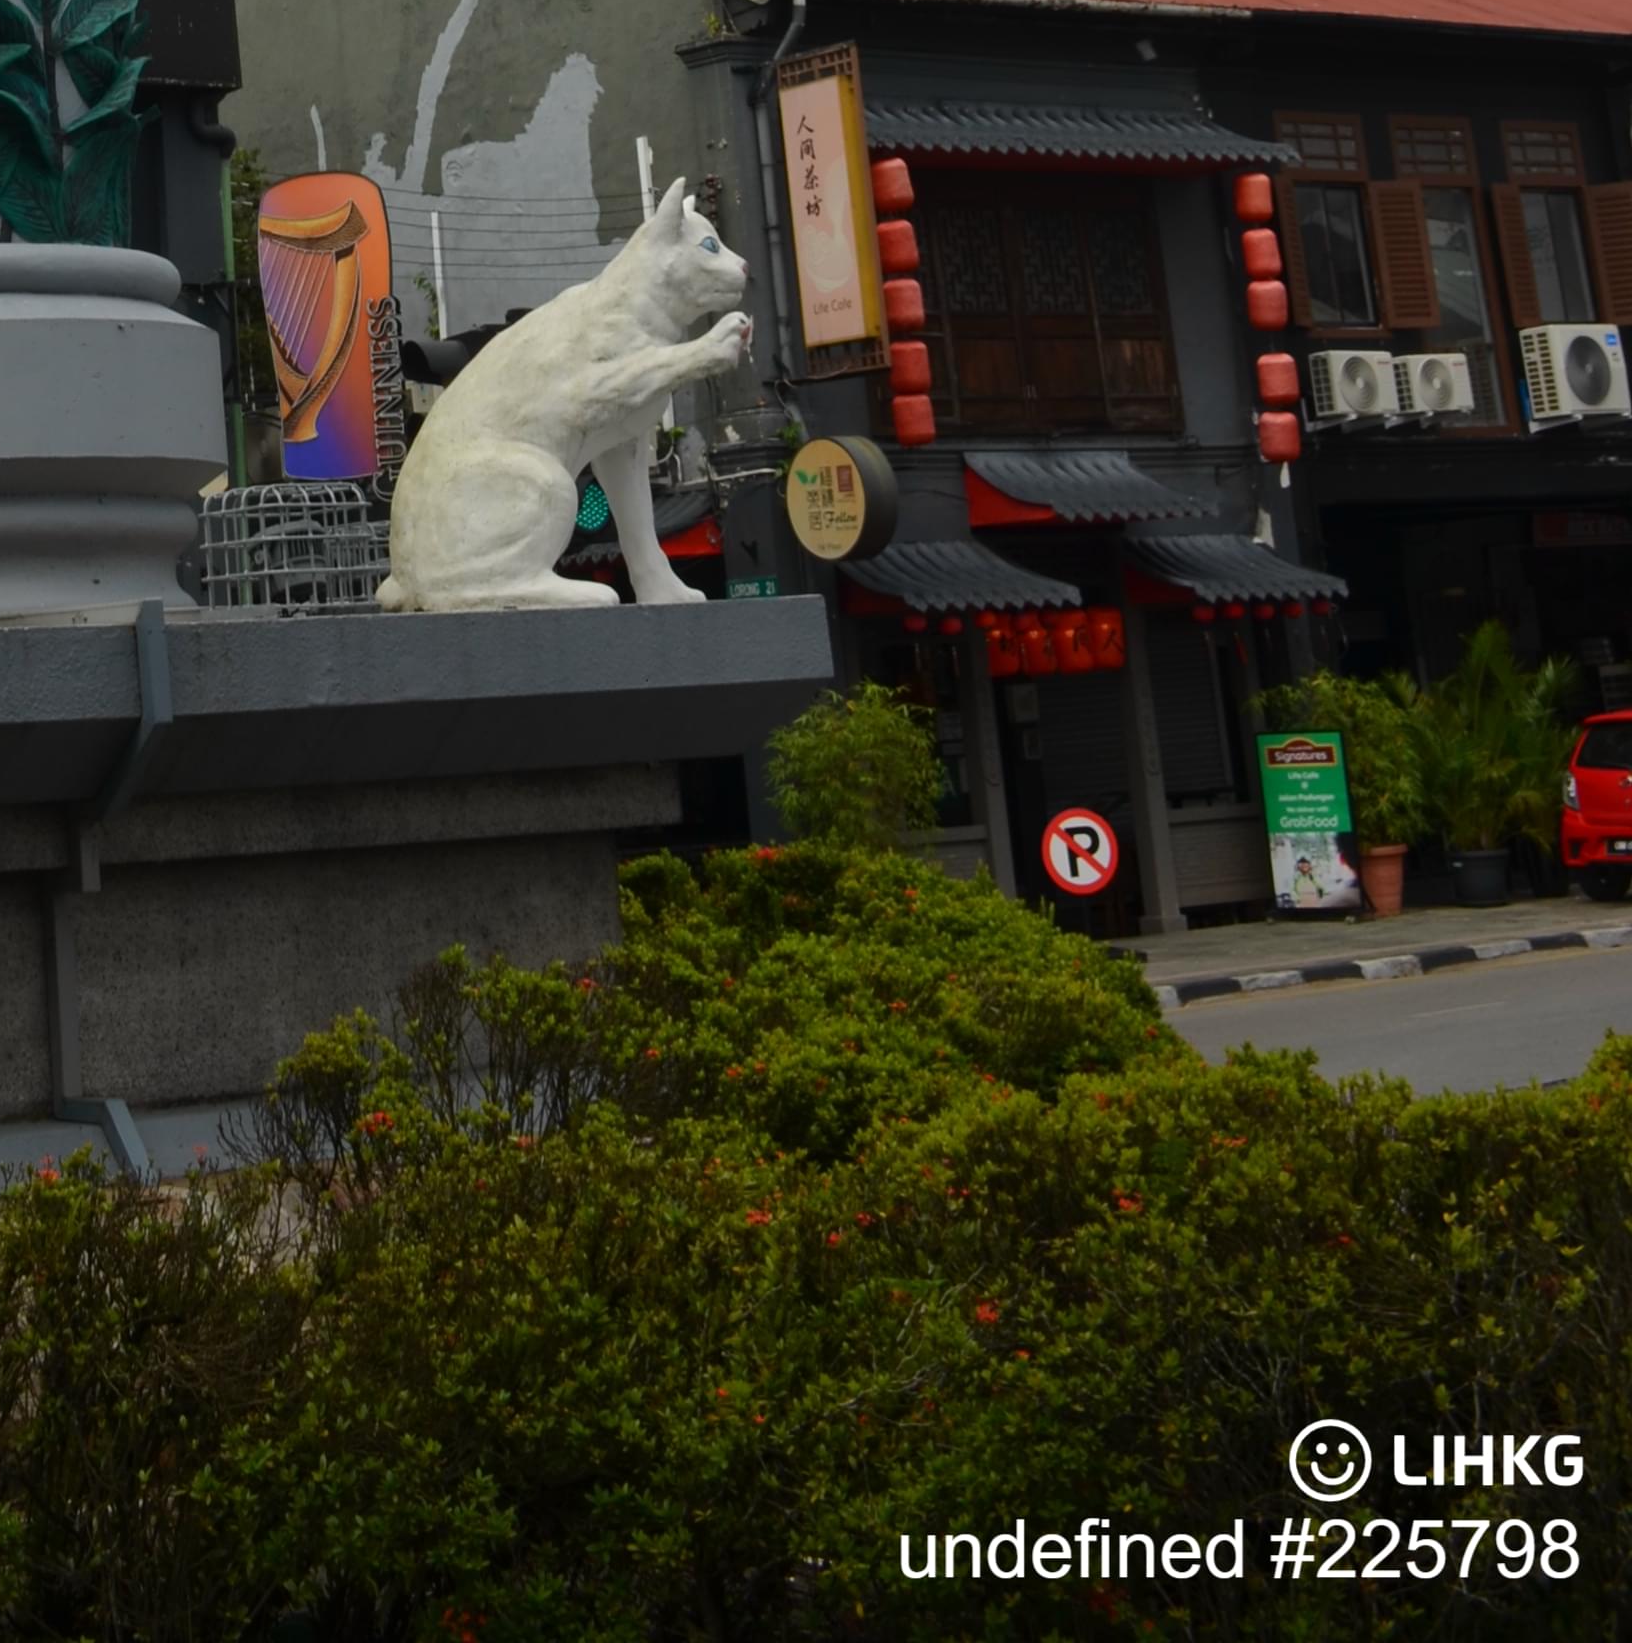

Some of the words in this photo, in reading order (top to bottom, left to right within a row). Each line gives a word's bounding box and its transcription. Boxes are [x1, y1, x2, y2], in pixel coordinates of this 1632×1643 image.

[367, 294, 407, 503] GUINNESS
[729, 581, 760, 598] LORONG
[1273, 750, 1328, 764] Signatures
[1279, 814, 1339, 828] GrabFood
